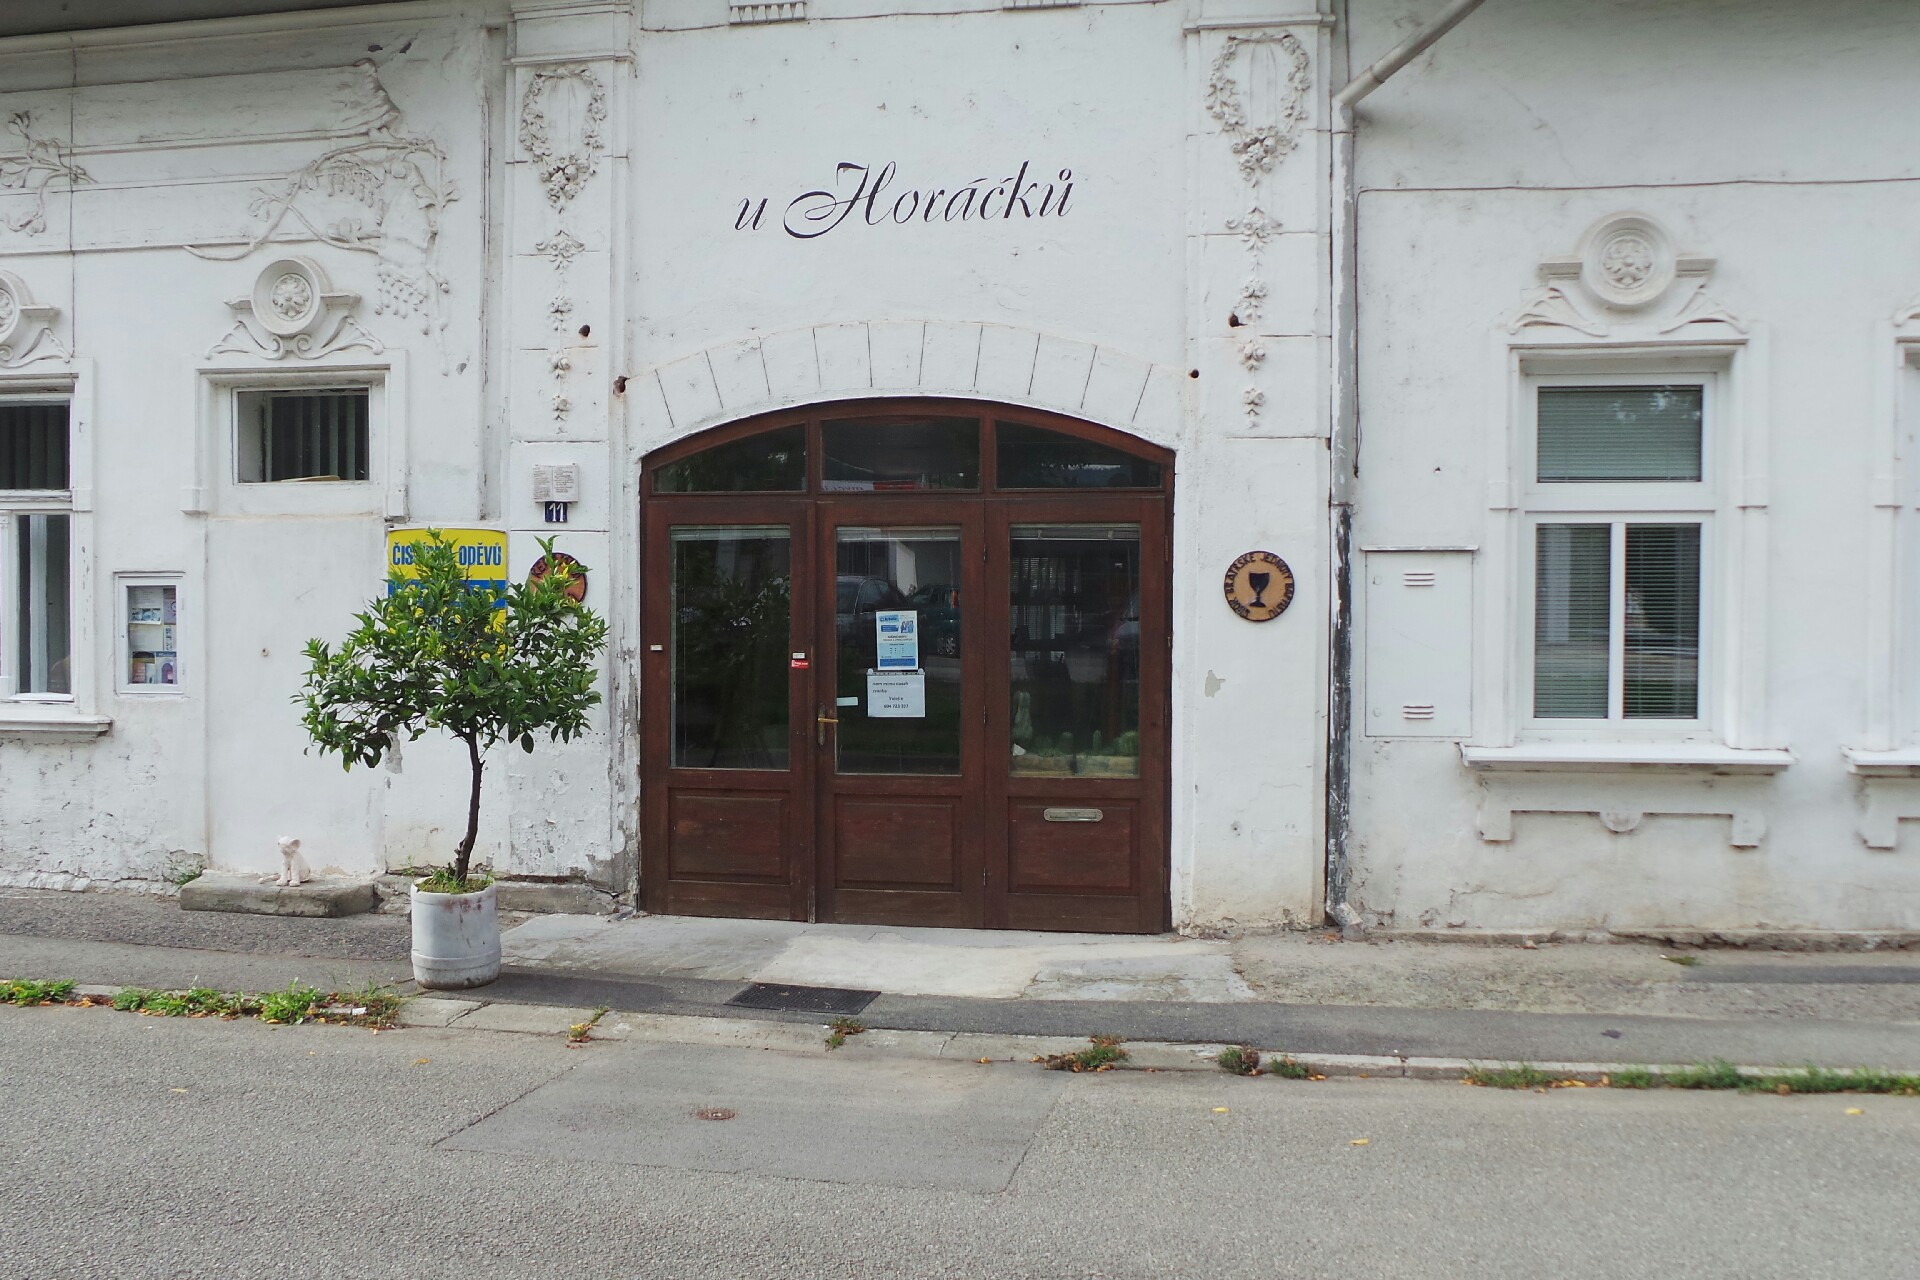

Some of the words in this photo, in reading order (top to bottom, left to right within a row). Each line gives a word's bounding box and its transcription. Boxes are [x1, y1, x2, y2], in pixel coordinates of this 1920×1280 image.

[734, 197, 768, 231] u
[783, 160, 1074, 239] Horáčků
[549, 502, 564, 522] 11
[458, 541, 502, 566] ODĚVŮ
